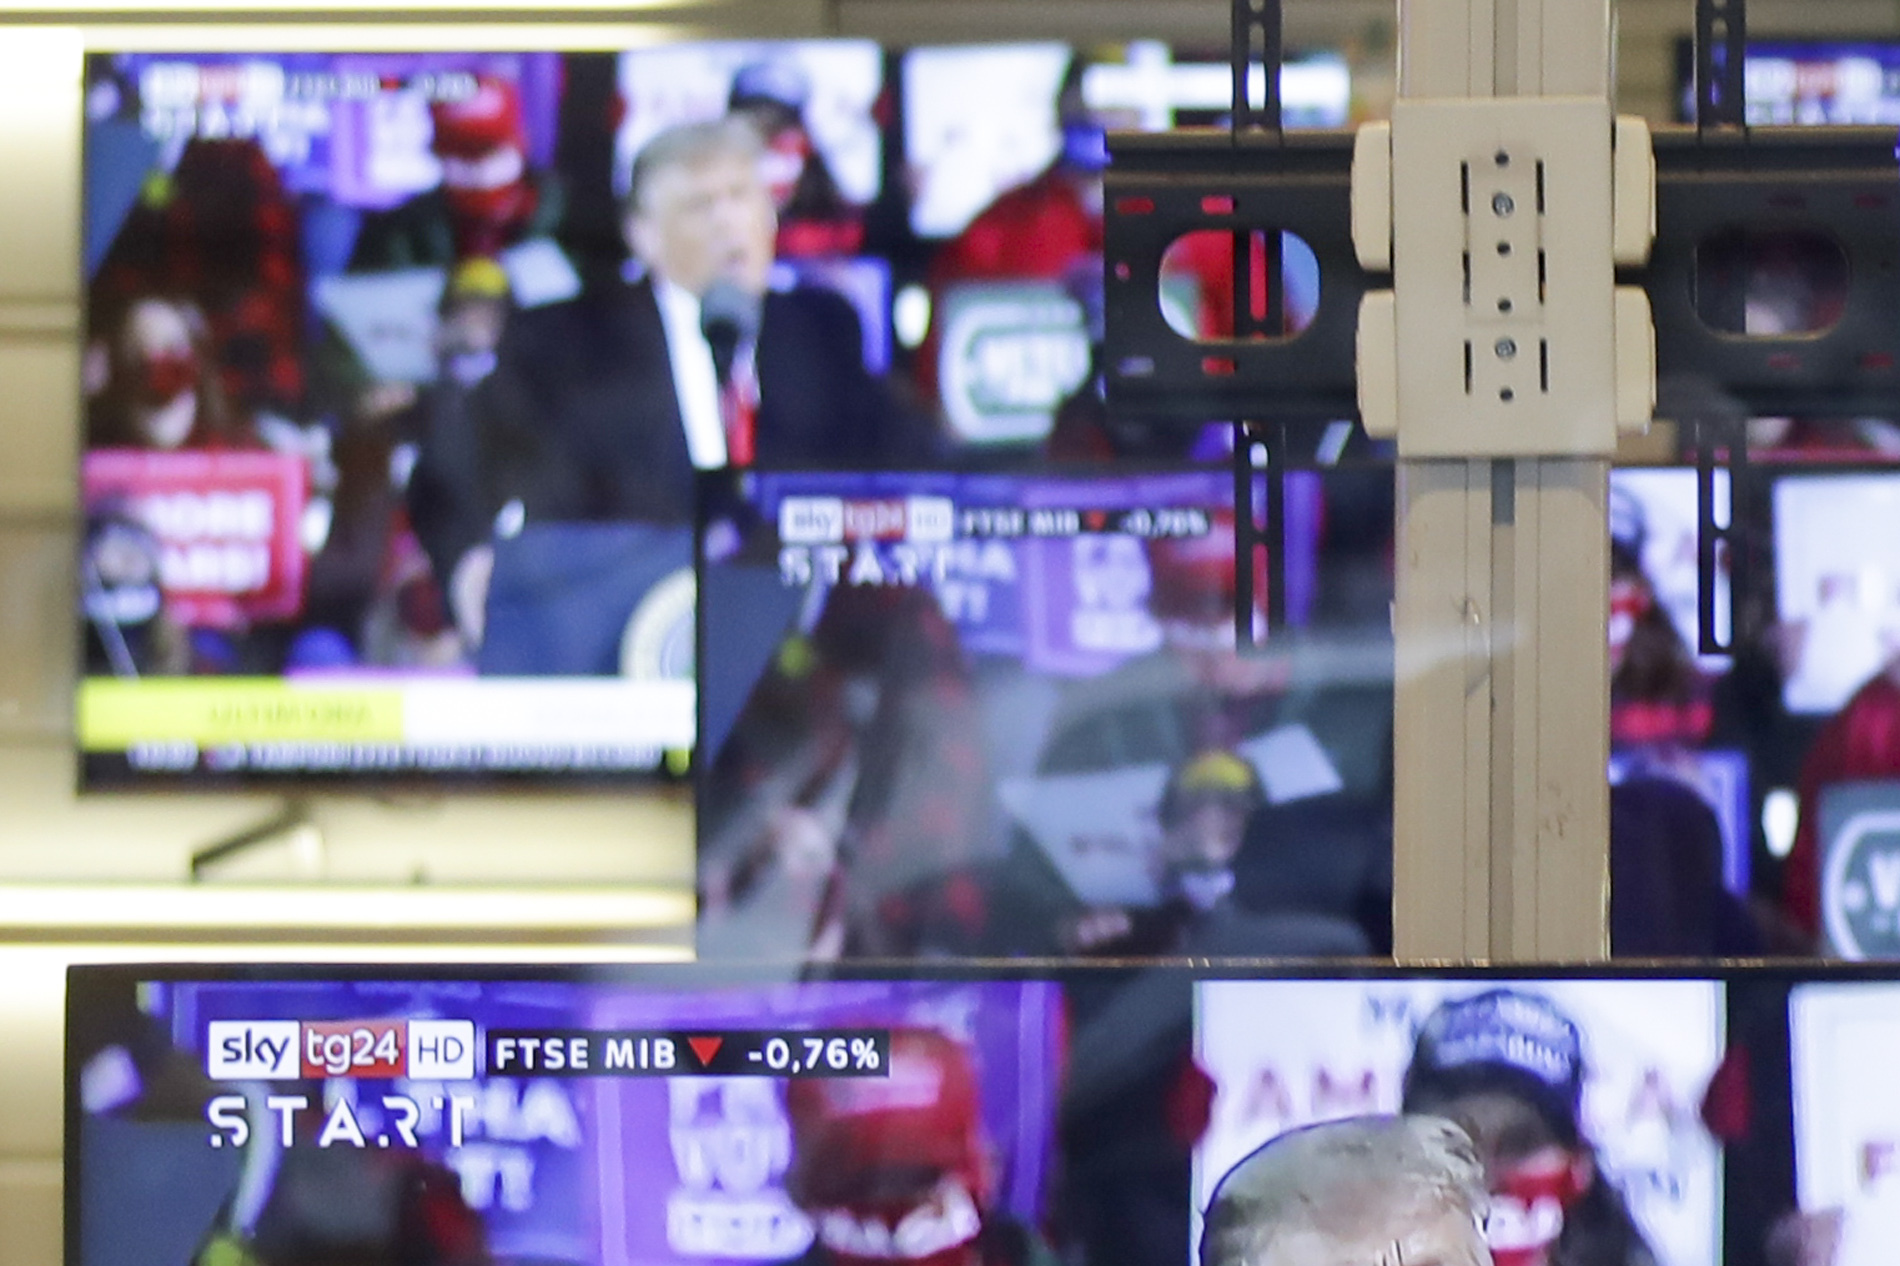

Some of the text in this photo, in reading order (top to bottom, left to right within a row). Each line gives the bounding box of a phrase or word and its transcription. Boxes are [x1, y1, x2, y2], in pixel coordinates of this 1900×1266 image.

[222, 1028, 880, 1074] sky tg24 HD FTSE MIB -0,76%
[207, 1096, 475, 1148] START
